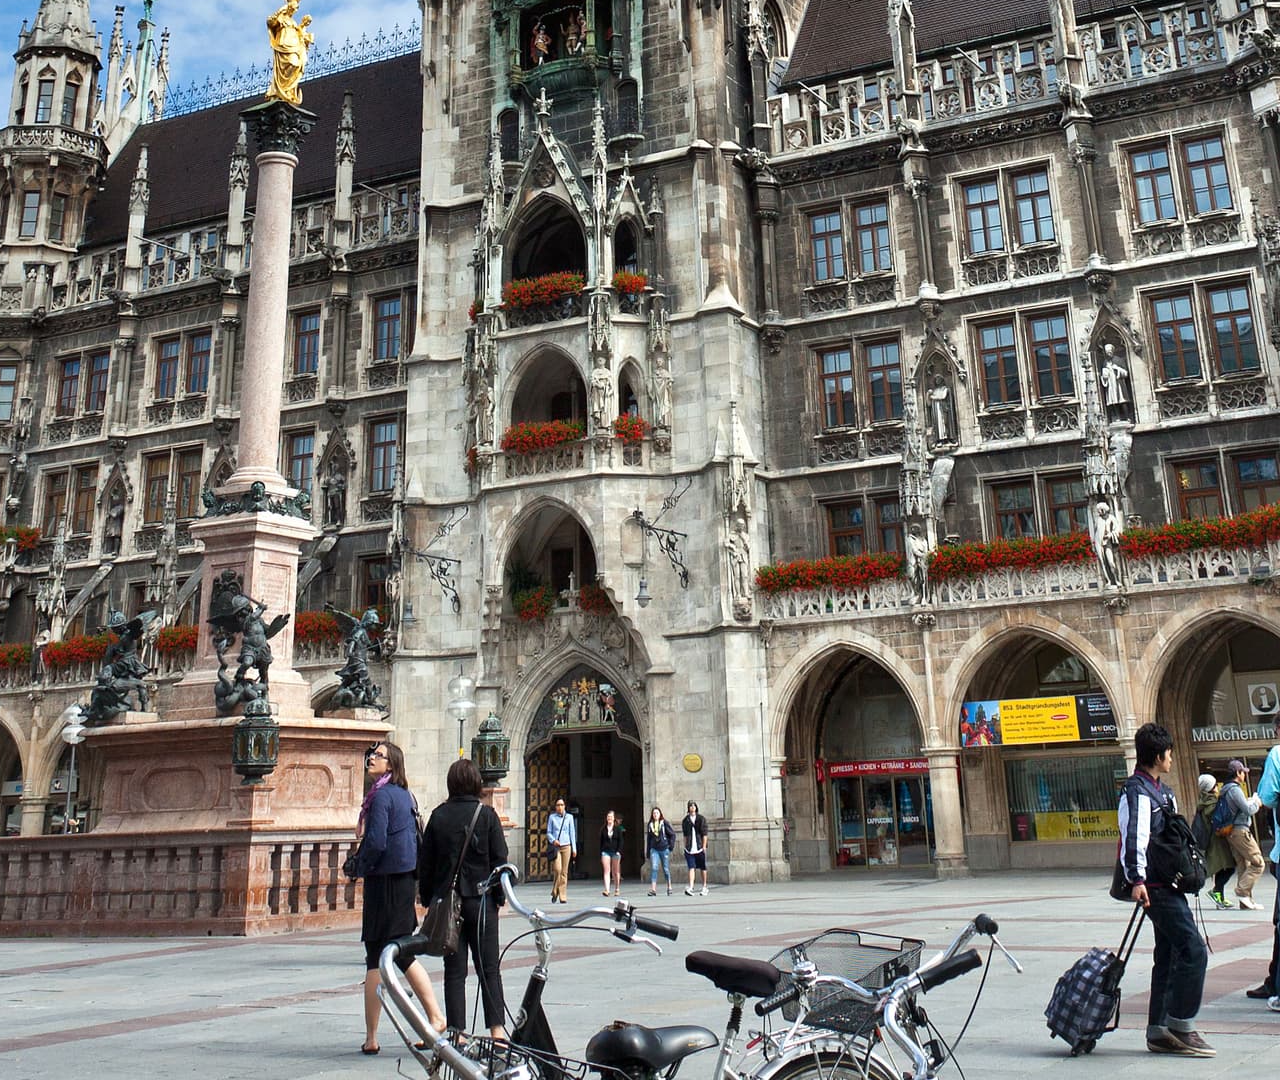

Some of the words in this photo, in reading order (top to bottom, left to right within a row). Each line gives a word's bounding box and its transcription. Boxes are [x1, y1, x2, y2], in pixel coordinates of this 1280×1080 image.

[1192, 727, 1258, 742] München
[830, 764, 854, 773] ESPRESSO
[1067, 814, 1100, 824] Tourist
